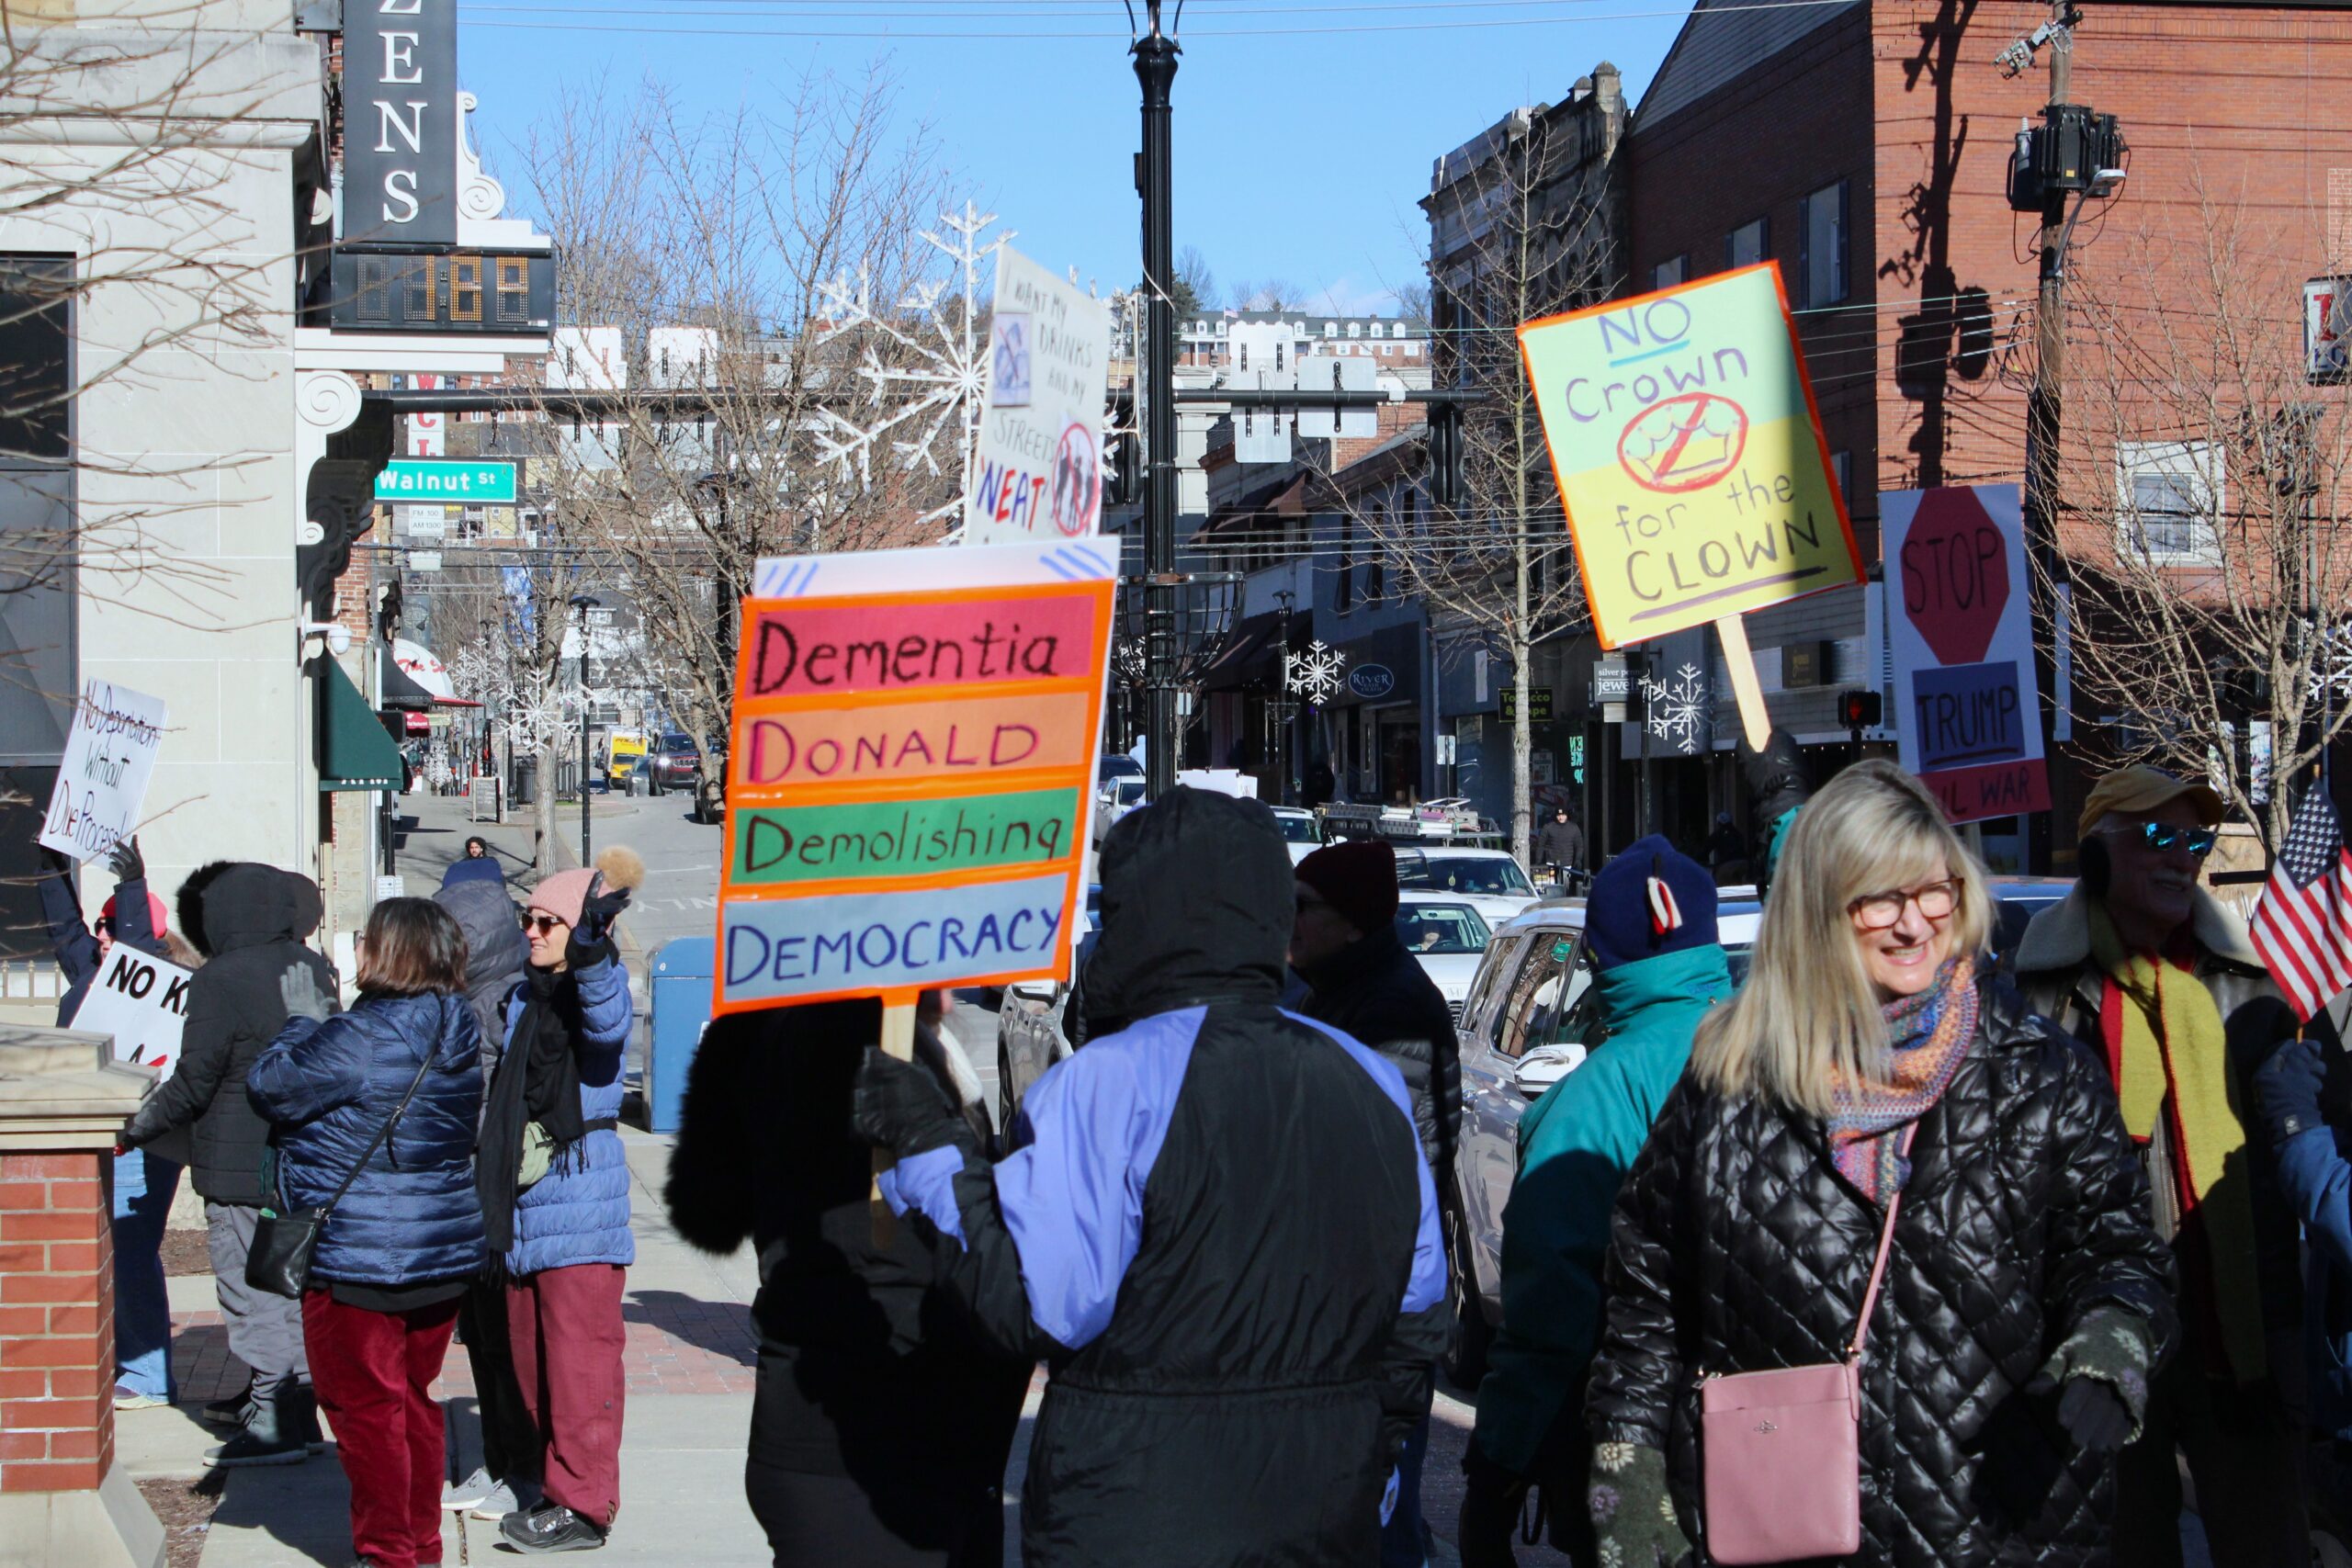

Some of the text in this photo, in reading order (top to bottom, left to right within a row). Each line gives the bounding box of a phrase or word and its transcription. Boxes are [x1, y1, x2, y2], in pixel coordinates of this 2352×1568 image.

[373, 0, 428, 223] ENS
[1014, 277, 1048, 313] WANT
[1050, 292, 1068, 326] MY
[1598, 298, 1691, 354] NO
[1039, 321, 1093, 368] DRINKS
[1047, 367, 1069, 395] AND
[1565, 346, 1748, 423] Crown
[994, 411, 1057, 464] STREETS
[379, 469, 495, 491] Walnut St
[1615, 468, 1794, 546] for the
[413, 509, 424, 517] FM
[425, 521, 442, 529] 1300
[1625, 511, 1821, 602] CLOWN
[1902, 527, 2000, 615] STOP
[752, 619, 1060, 696] Dementia
[1598, 668, 1620, 677] silver
[77, 680, 162, 750] No Deportation
[1500, 693, 1551, 703] Tocco
[1917, 685, 2018, 752] TRUMP
[748, 719, 1041, 784] DONALD
[49, 779, 77, 839] Due
[1979, 766, 2031, 811] WAR
[744, 809, 1064, 874] Demolishing
[724, 906, 1063, 987] DEMOCRACY
[106, 953, 156, 1000] NO
